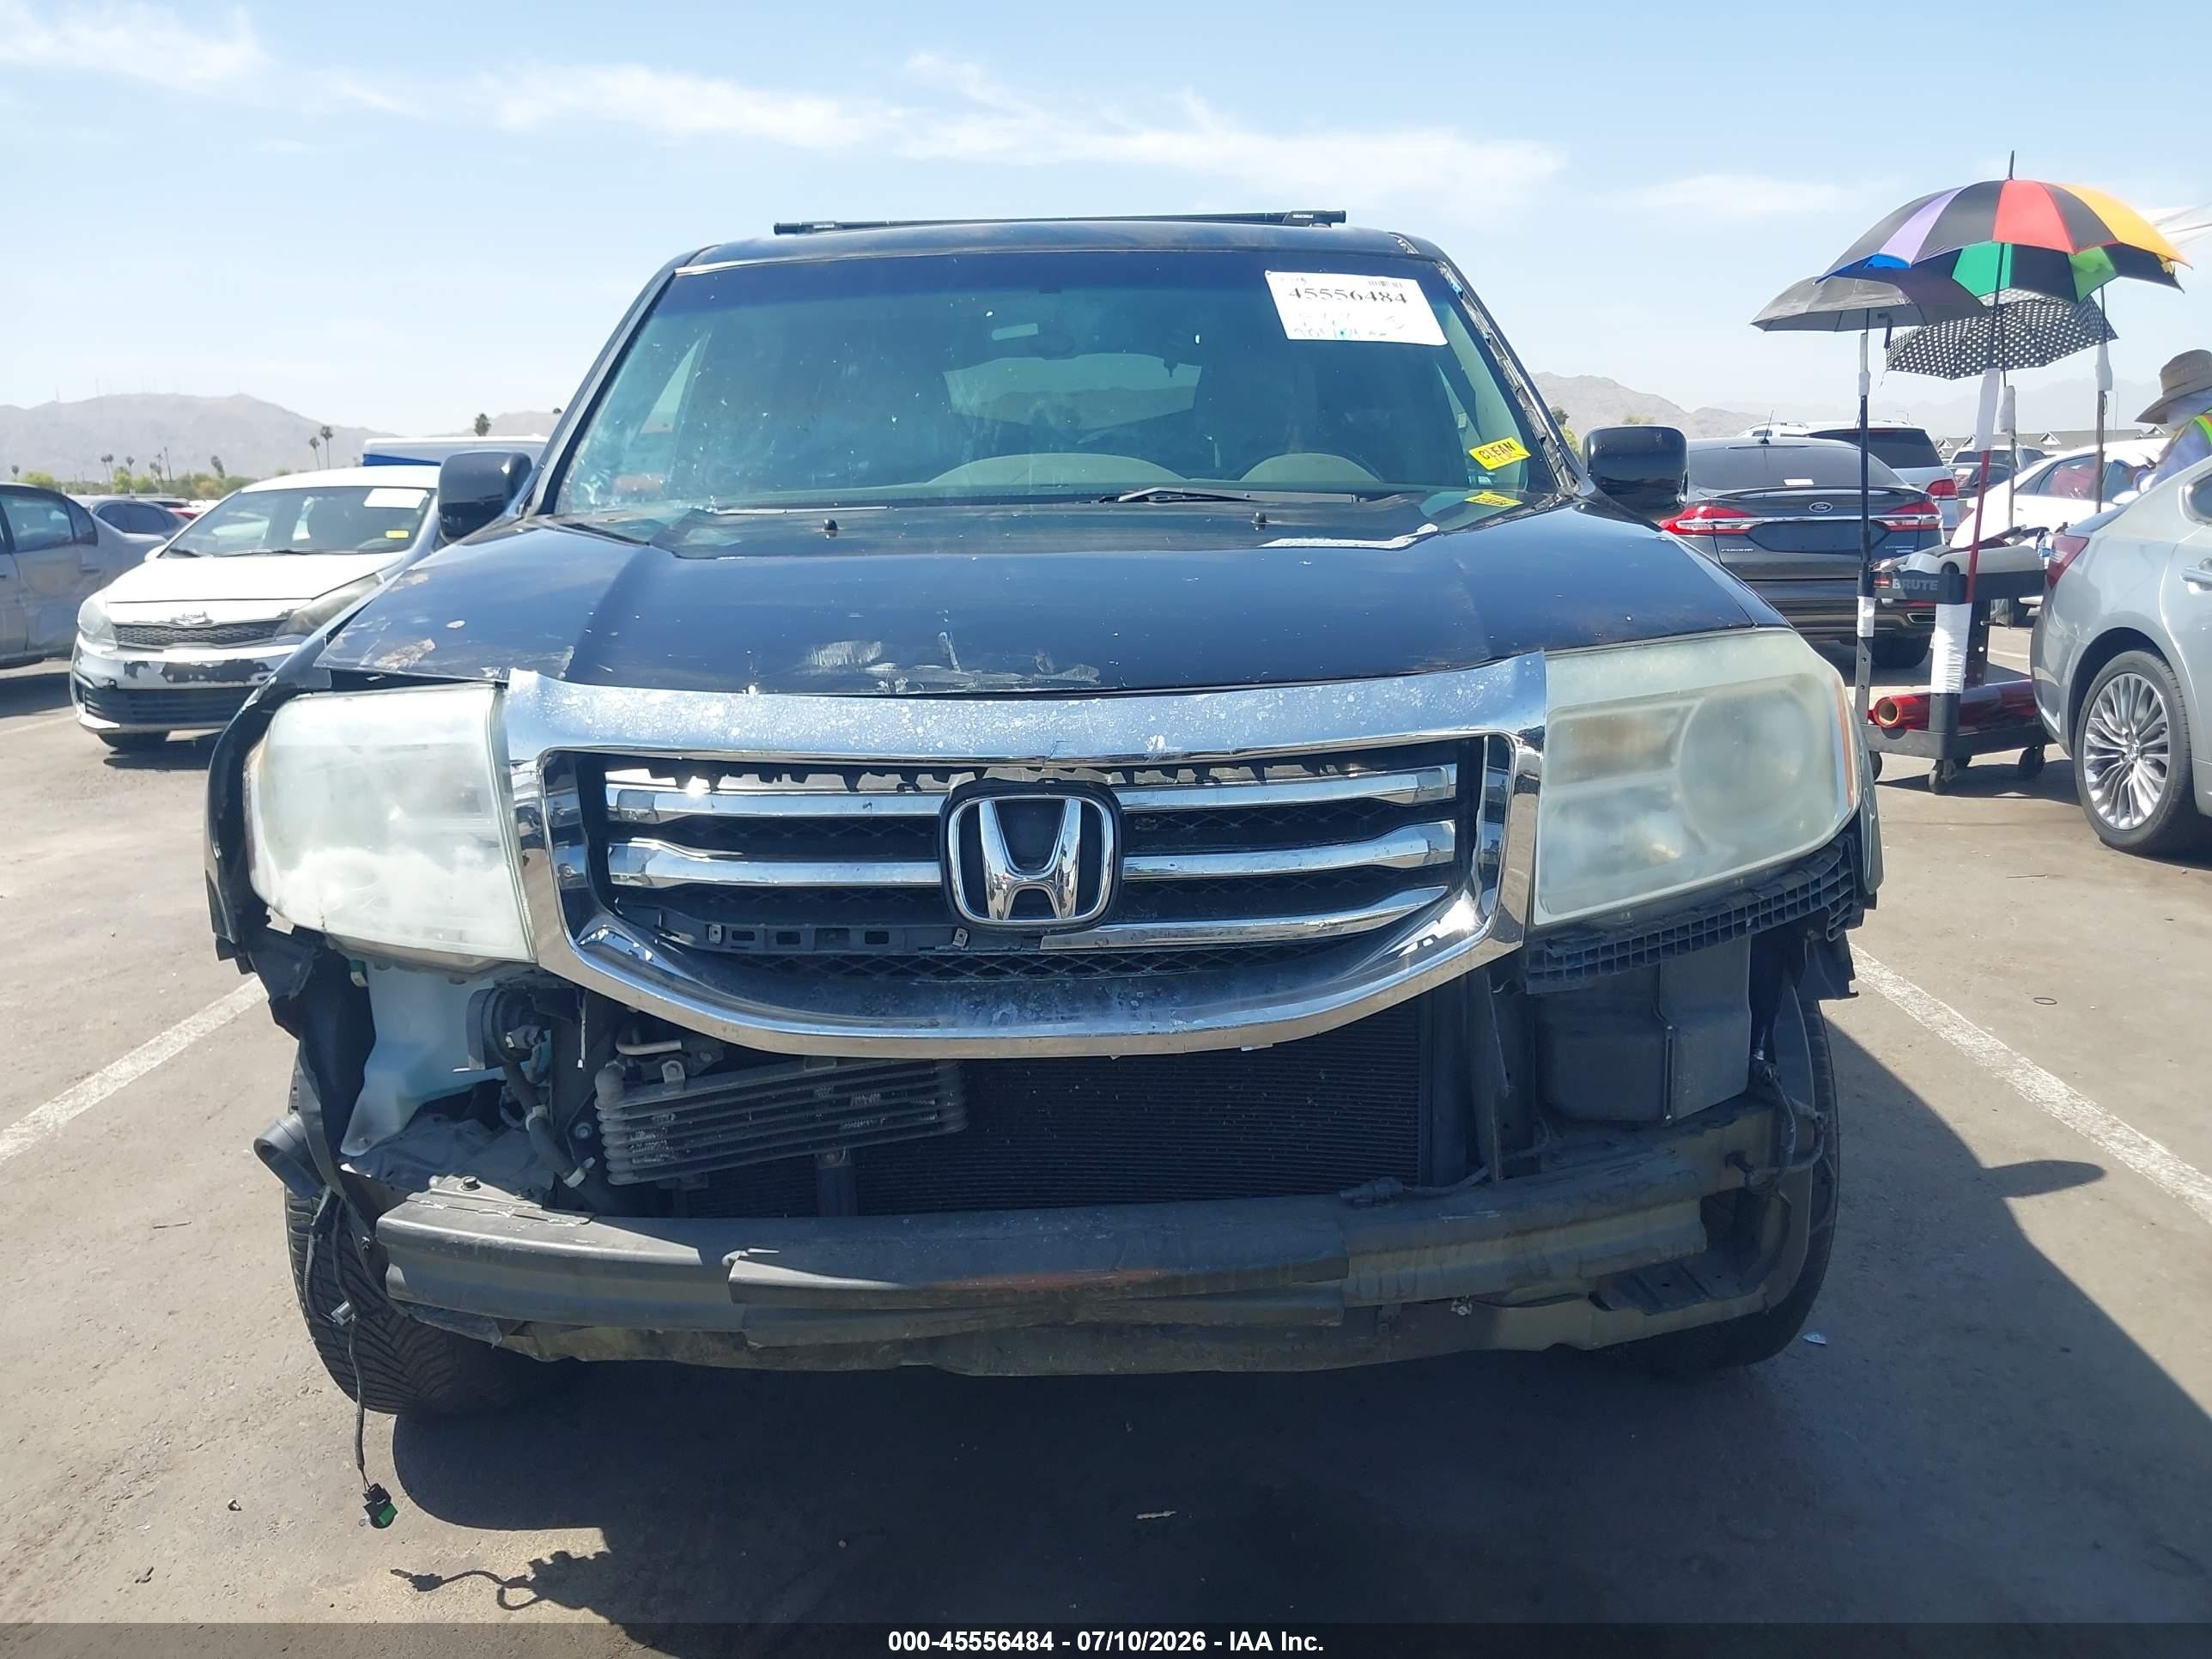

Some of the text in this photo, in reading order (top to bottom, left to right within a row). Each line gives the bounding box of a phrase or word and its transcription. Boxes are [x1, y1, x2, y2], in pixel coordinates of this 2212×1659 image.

[1288, 287, 1407, 304] 45556484
[1478, 441, 1516, 460] CLEAN
[1892, 579, 1938, 591] BRUTE
